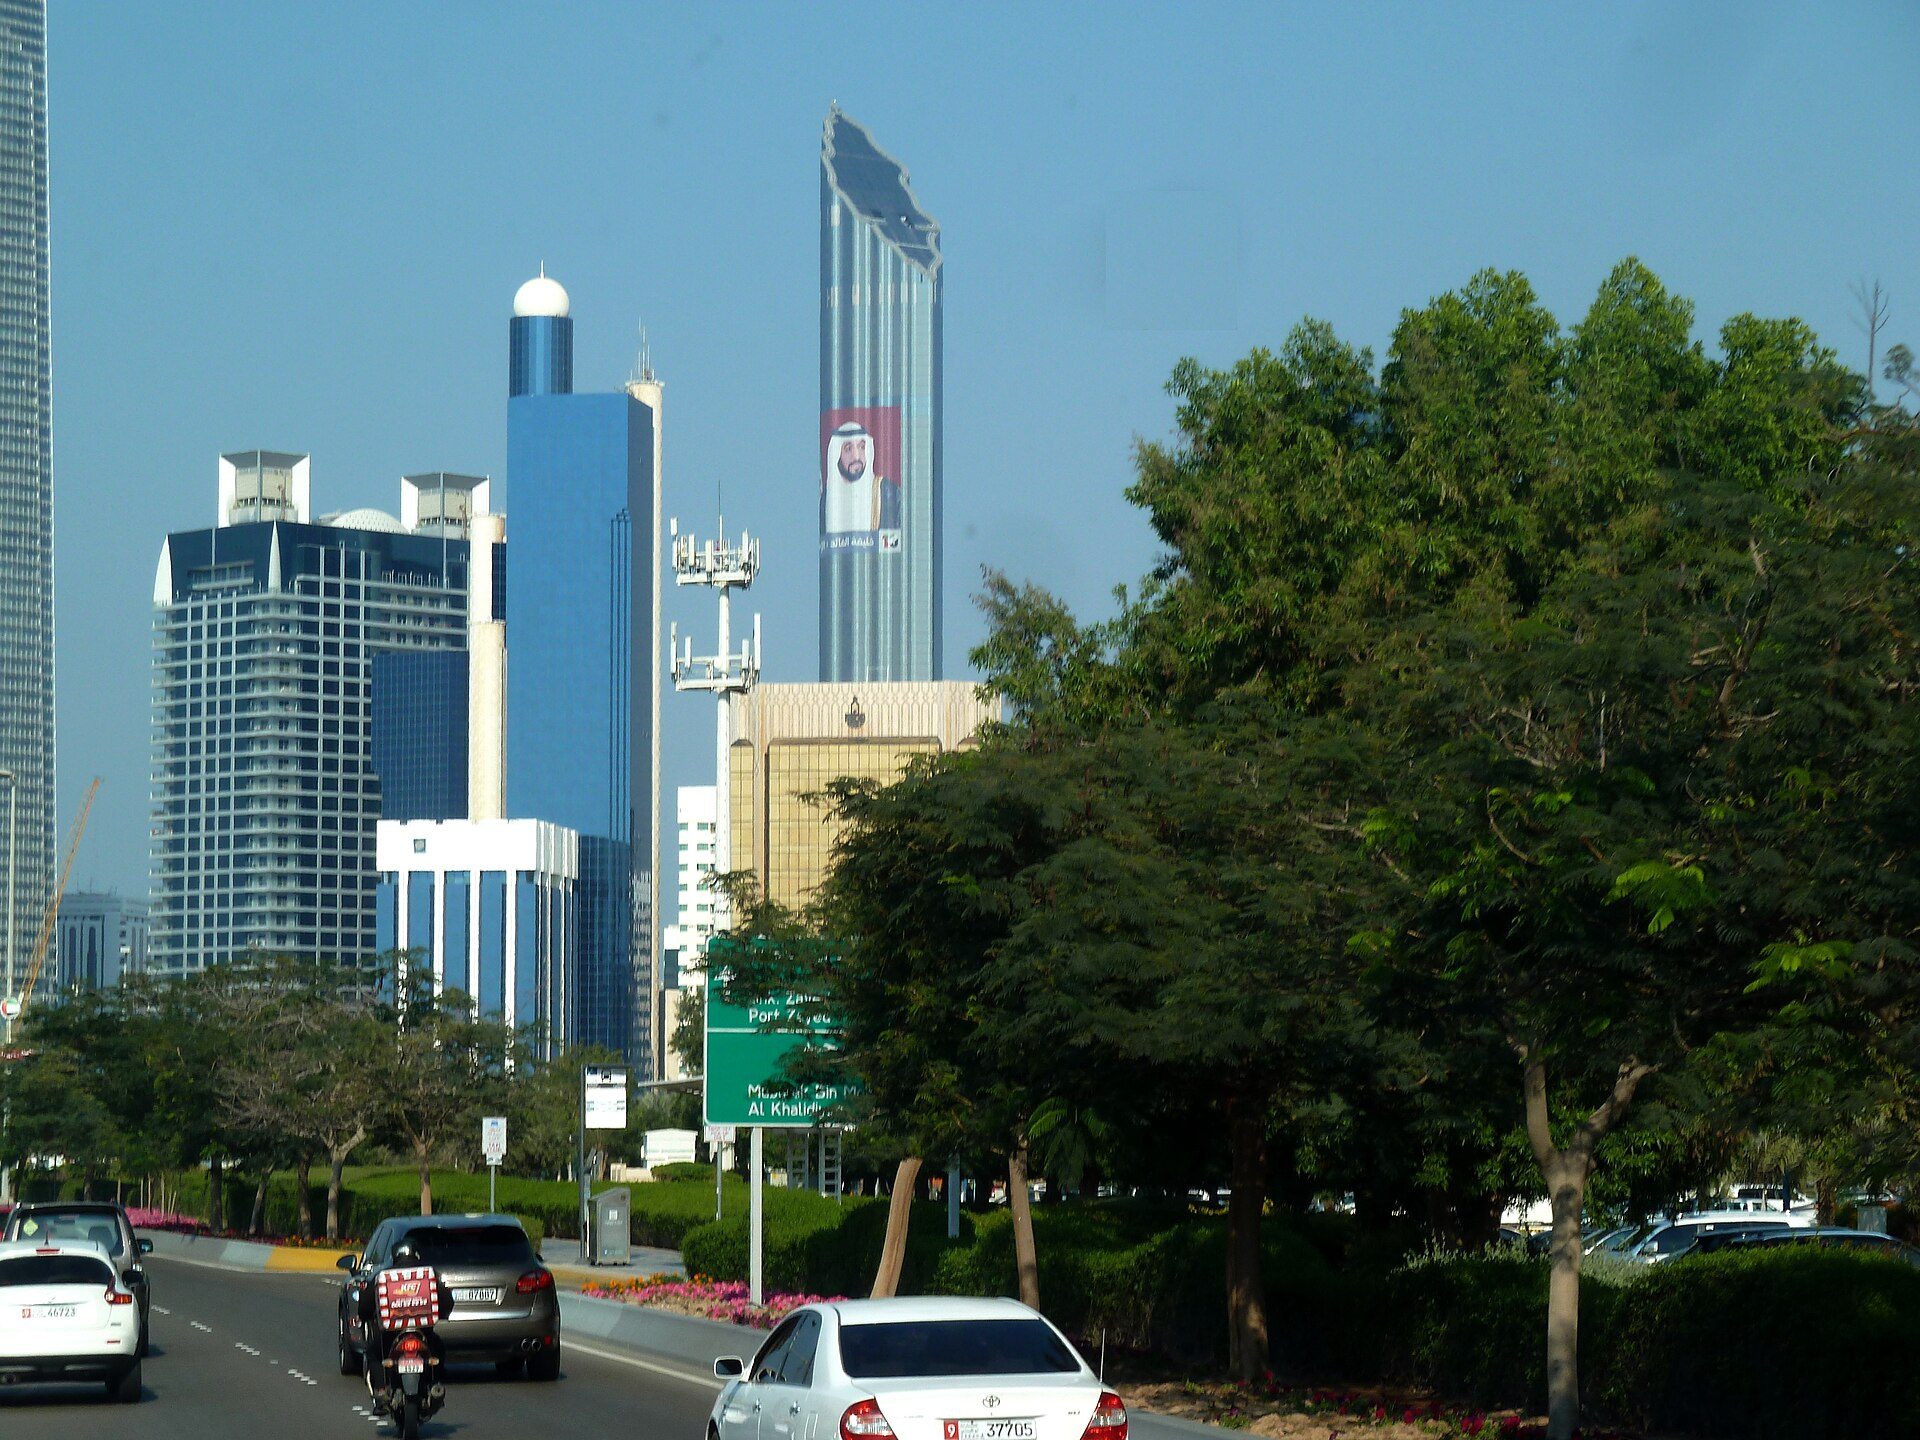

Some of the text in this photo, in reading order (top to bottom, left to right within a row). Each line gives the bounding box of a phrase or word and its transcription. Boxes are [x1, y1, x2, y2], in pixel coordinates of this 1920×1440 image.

[749, 1007, 780, 1023] Port
[815, 1083, 838, 1100] Bin
[748, 1101, 764, 1117] Al
[401, 1282, 418, 1292] KFC
[947, 1423, 957, 1438] 9
[986, 1422, 1034, 1438] 37705
